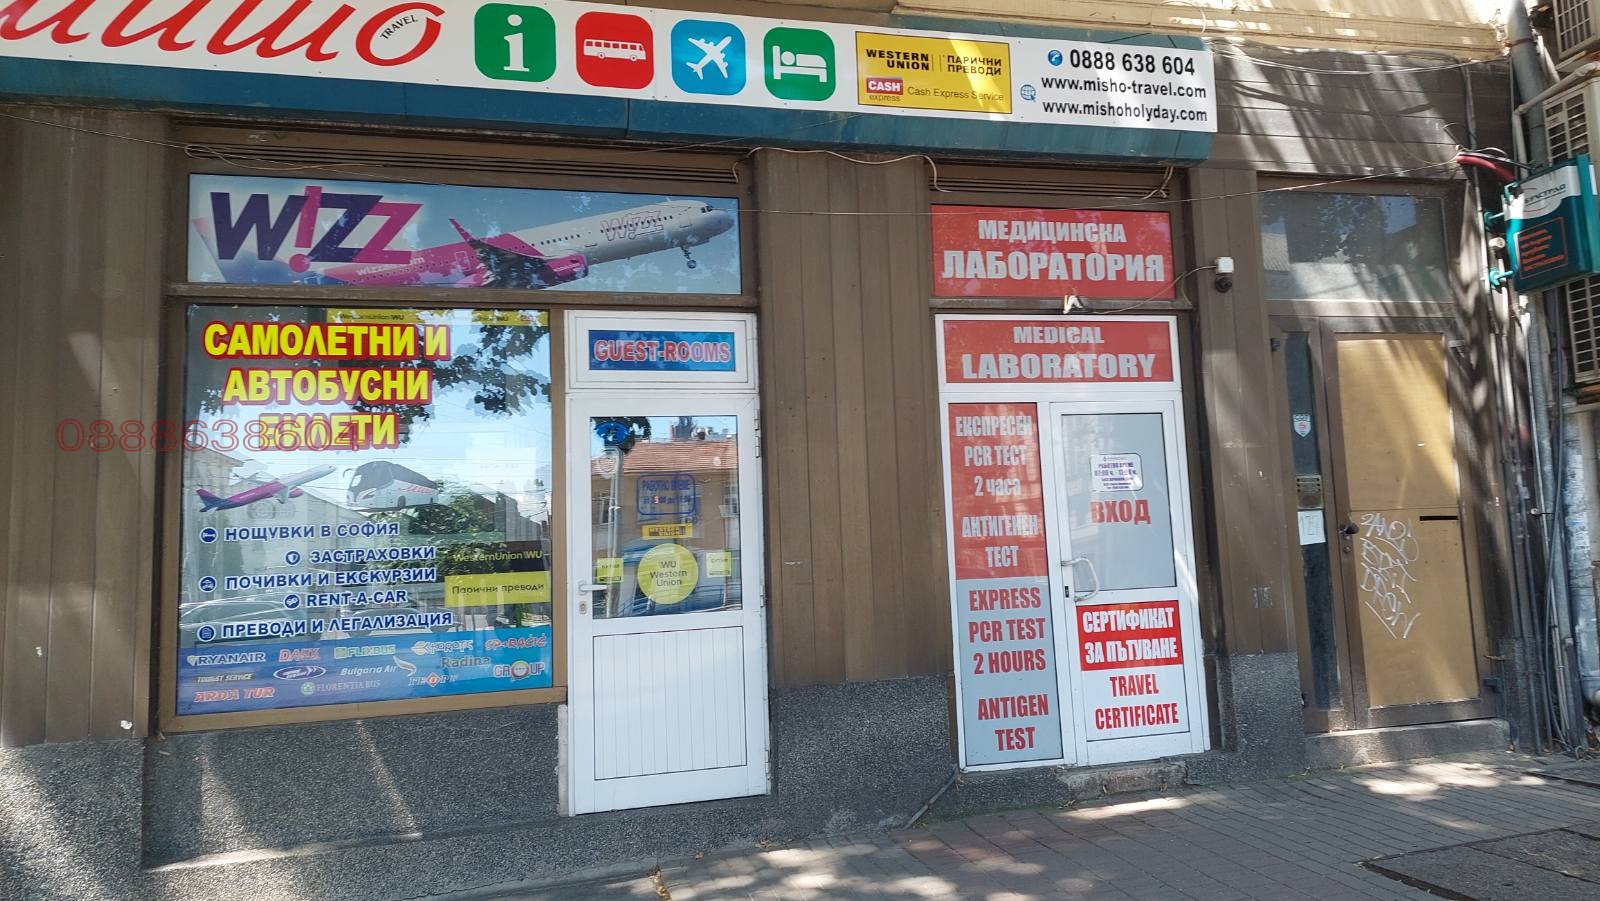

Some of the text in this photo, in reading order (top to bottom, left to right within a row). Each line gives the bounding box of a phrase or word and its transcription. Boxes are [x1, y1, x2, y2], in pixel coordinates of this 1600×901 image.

[380, 15, 418, 40] TRAVEL
[866, 49, 929, 61] WESTERN
[887, 60, 929, 70] UNION
[947, 55, 1001, 66] ПАРИЧНИ
[1070, 49, 1195, 75] 0888 638 604
[947, 65, 1001, 76] ПРЕВОДИ
[868, 80, 901, 92] CASH
[907, 86, 930, 96] Cash
[934, 88, 969, 100] Express
[1041, 77, 1206, 98] www.misho-travel.com
[869, 94, 900, 102] express
[1042, 101, 1208, 123] www.mishoholyday.com
[978, 219, 1127, 244] МЕДИЦИНСКА
[942, 250, 1165, 281] ЛАБОРАТОРИЯ
[204, 322, 449, 358] САМОЛЕТНИ И
[1013, 326, 1105, 344] MEDICAL
[593, 340, 731, 362] GUEST-ROOMS
[961, 353, 1156, 379] LABORATORY
[222, 369, 431, 404] АВТОБУСНИ
[258, 412, 400, 449] БИЛЕТИ
[955, 415, 1032, 437] ЕКСПРЕСЕН
[964, 445, 1028, 466] PCR ТЕСТ
[974, 476, 1021, 497] 2 часа
[1090, 499, 1152, 525] ВХОД
[224, 522, 400, 542] НОЩУВКИ В СОФИЯ
[310, 547, 436, 563] ЗАСТРАХОВКИ
[985, 545, 1019, 568] ТЕСТ
[225, 568, 437, 590] ПОЧИВКИ И ЕКСКУРЗИИ
[650, 570, 688, 579] Western
[656, 578, 682, 587] Union
[306, 590, 408, 608] RENT-A-CAR
[452, 584, 544, 595] Парични преводи
[969, 586, 1041, 611] EXPRESS
[221, 612, 453, 639] ПРЕВОДИ И ЛЕГАЛИЗАЦИЯ
[968, 617, 1046, 643] PCR TEST
[1082, 607, 1175, 633] СЕРТИФИКАТ
[198, 652, 266, 665] RYANAIR
[973, 649, 1047, 674] 2 HOURS
[1085, 637, 1178, 664] ЗА ПЪТУВАНЕ
[1110, 674, 1159, 698] TRAVEL
[978, 694, 1049, 721] ANTIGEN
[1095, 703, 1179, 730] CERTIFICATE
[995, 726, 1036, 752] TEST
